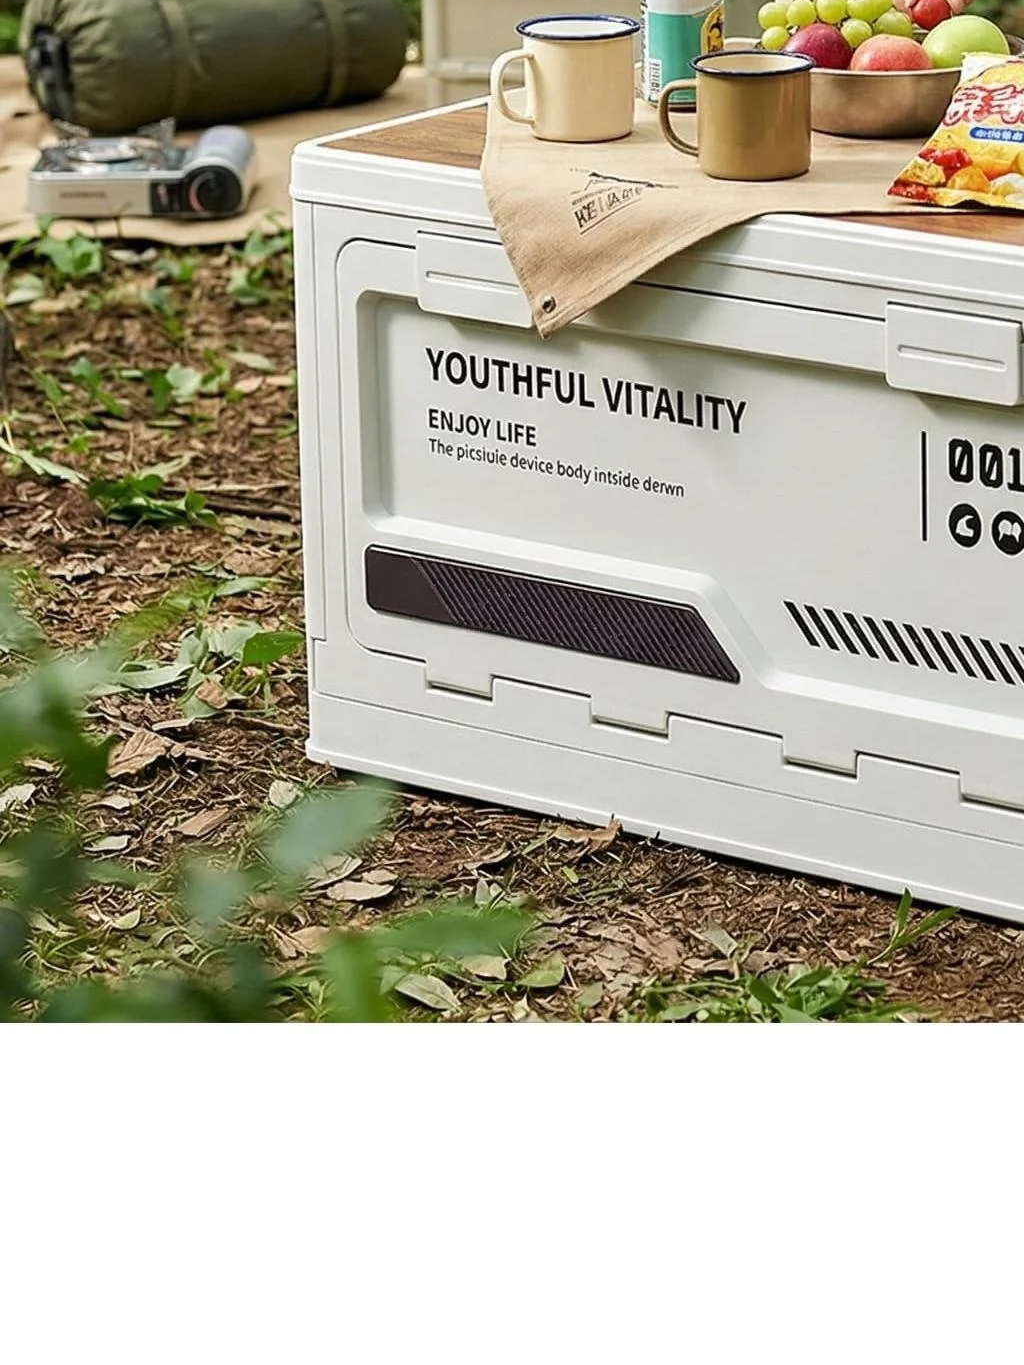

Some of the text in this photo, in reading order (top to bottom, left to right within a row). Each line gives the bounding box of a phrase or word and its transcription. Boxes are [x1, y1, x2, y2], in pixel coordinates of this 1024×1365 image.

[425, 347, 747, 434] YOUTHFUL VITALITY
[428, 408, 537, 447] ENJOY LIFE
[428, 438, 454, 457] The
[510, 453, 554, 475] device
[556, 460, 592, 485] body
[594, 467, 640, 490] intside
